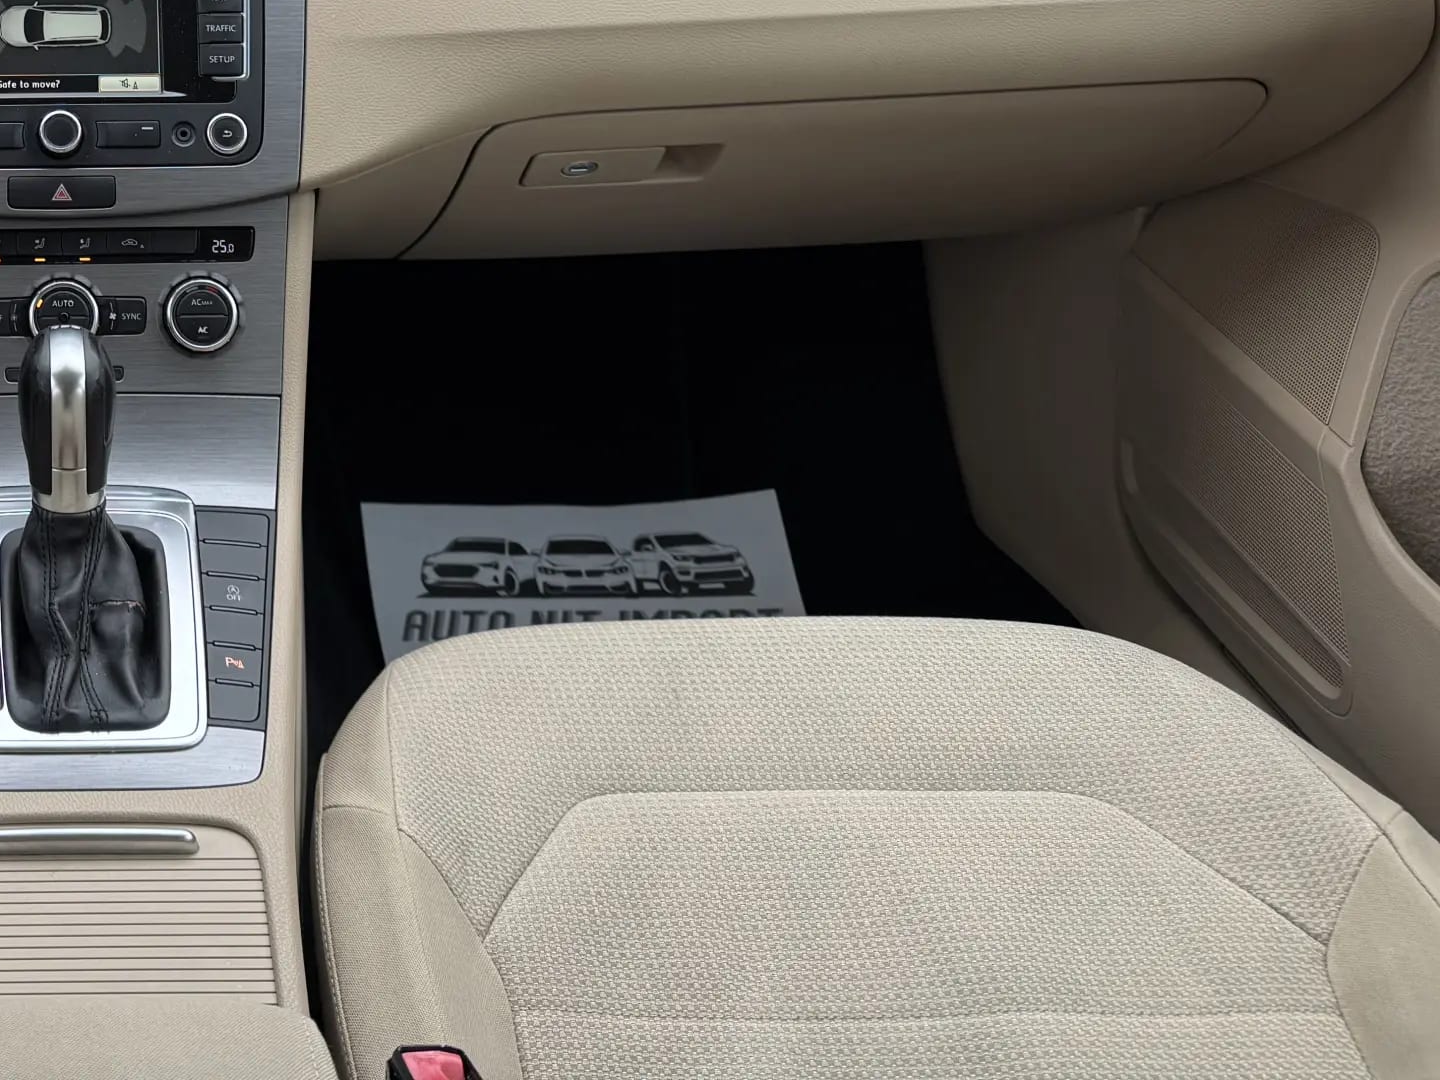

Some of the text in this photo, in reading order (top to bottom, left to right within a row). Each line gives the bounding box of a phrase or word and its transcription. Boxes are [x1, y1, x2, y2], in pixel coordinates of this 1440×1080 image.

[205, 24, 236, 32] TRAFFIC
[209, 55, 235, 63] SETUP
[20, 80, 29, 89] to
[32, 79, 60, 89] move?
[52, 299, 74, 307] AUTO
[121, 312, 142, 320] SYNC
